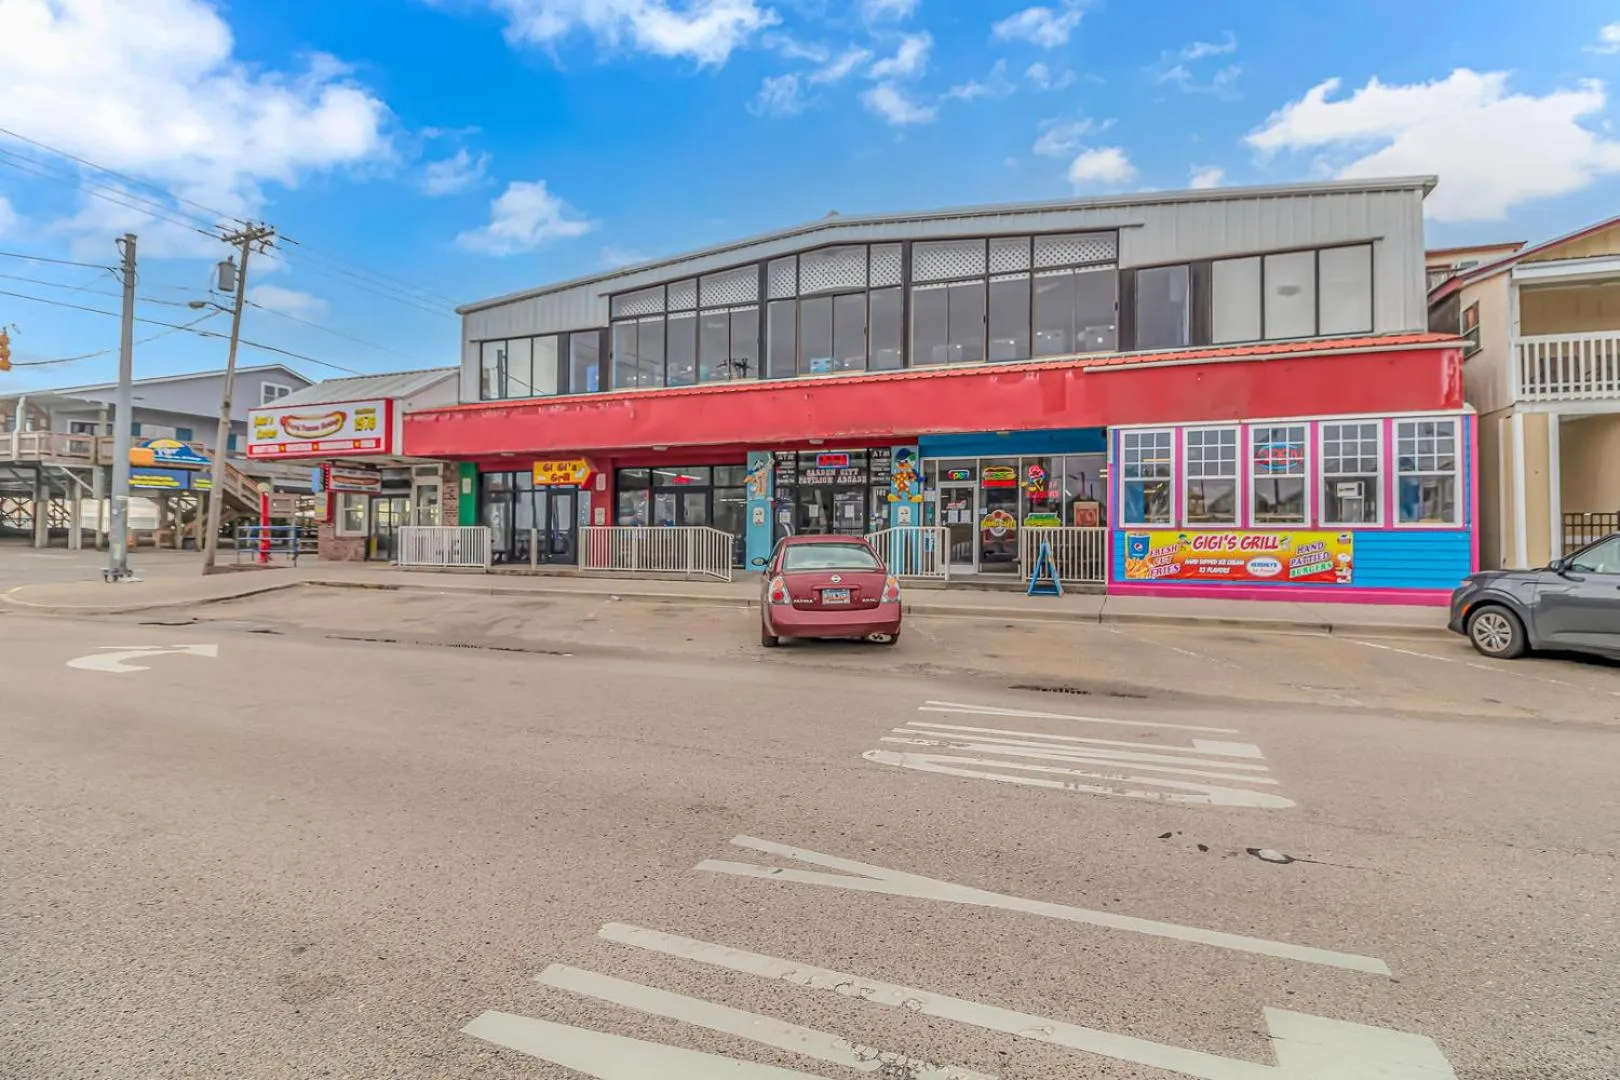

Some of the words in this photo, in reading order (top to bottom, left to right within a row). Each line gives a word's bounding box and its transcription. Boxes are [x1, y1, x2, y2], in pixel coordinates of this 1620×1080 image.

[798, 475, 834, 484] PAVILION
[837, 475, 867, 484] ARCADE
[806, 468, 836, 477] GARDEN
[1192, 534, 1237, 550] GIGI'S
[1241, 534, 1279, 550] GRILL
[1296, 541, 1325, 555] HAND
[1150, 544, 1178, 557] FRESH
[1150, 563, 1179, 577] FRIES
[1290, 562, 1333, 577] BURGERS
